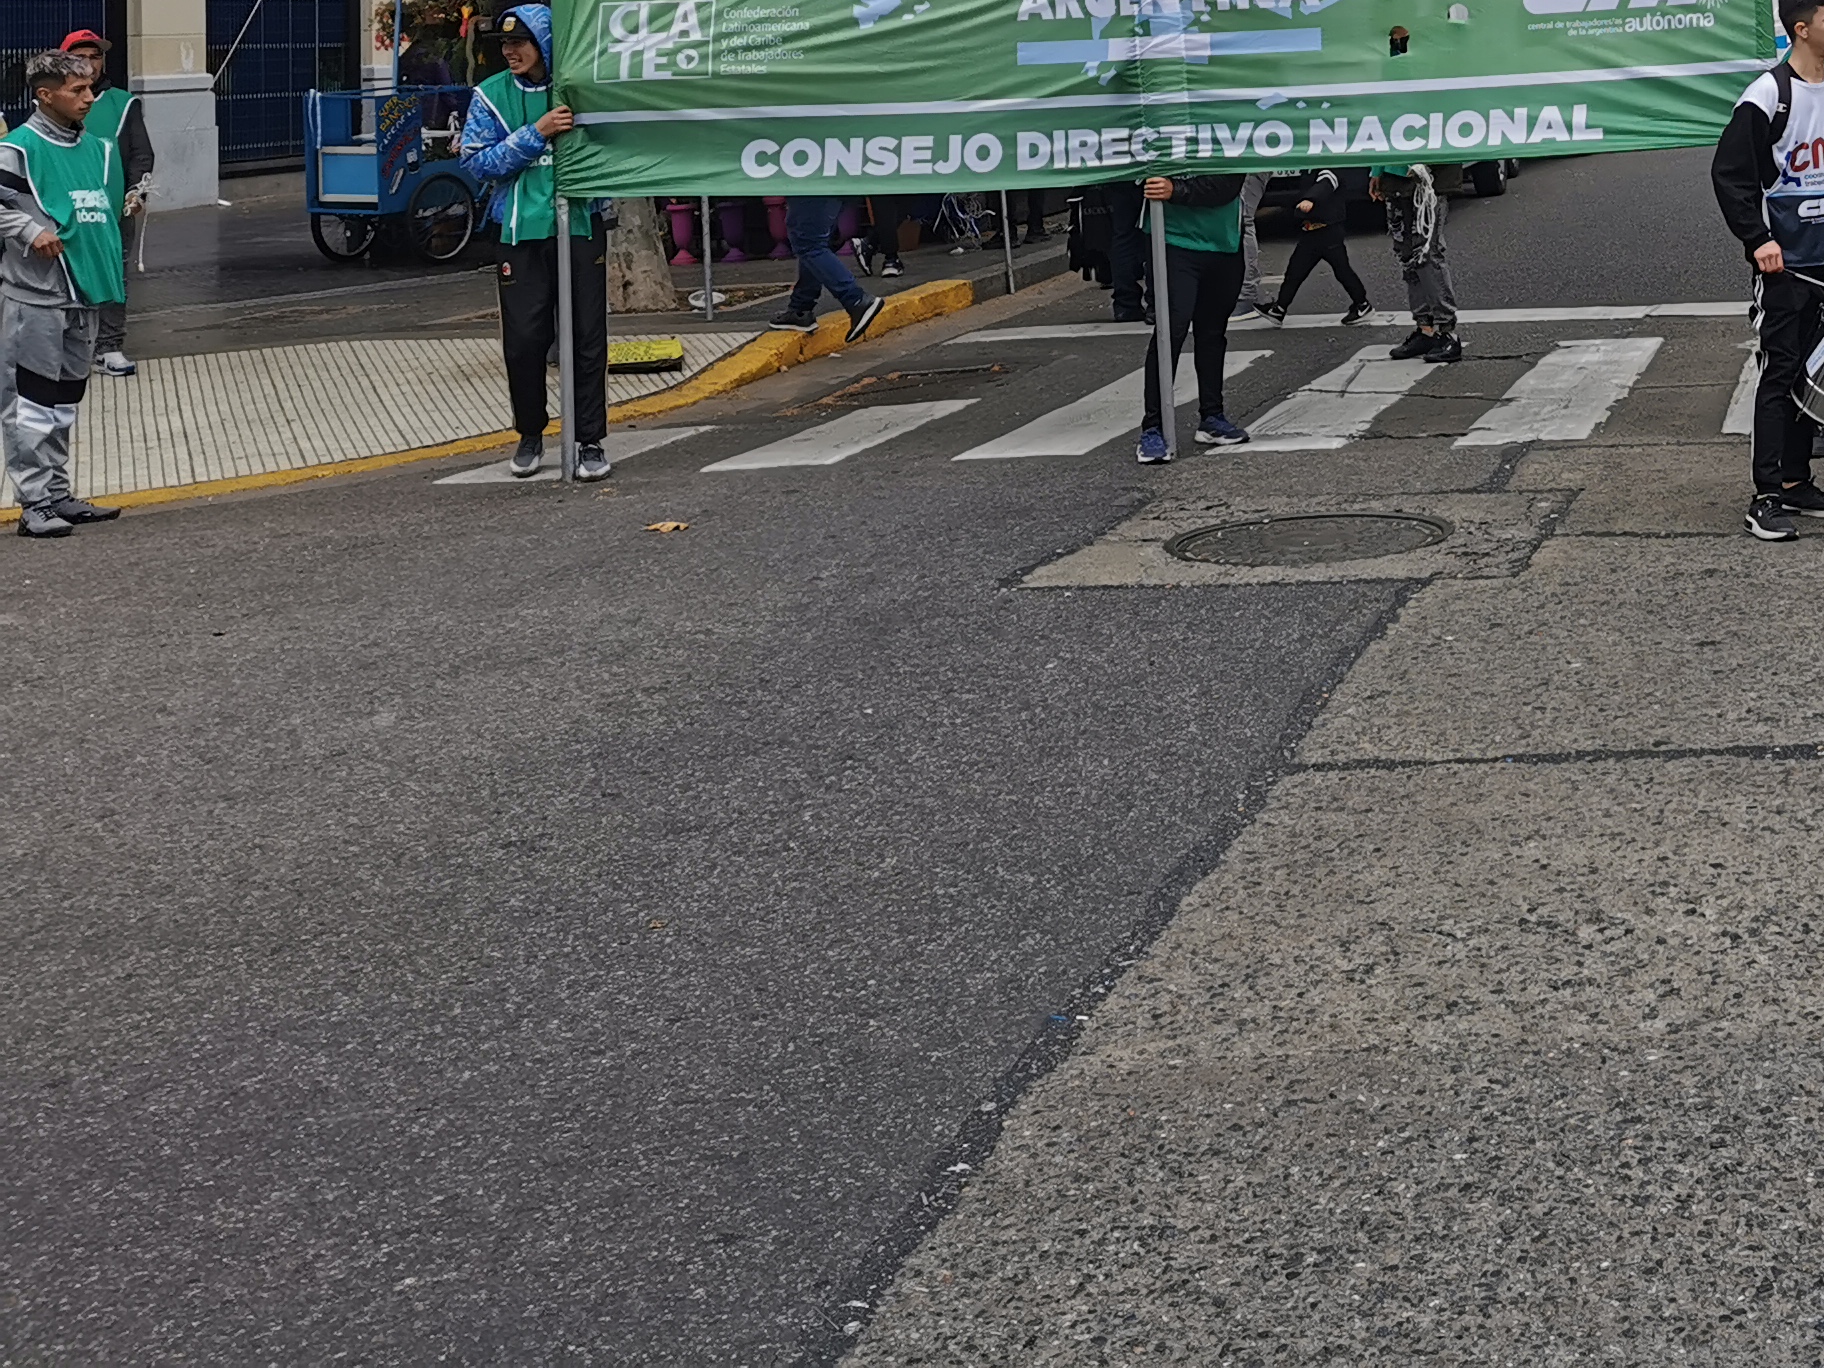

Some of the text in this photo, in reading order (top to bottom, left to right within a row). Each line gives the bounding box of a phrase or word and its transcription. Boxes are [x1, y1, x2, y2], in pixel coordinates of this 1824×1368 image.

[723, 6, 799, 18] Confederación
[722, 21, 810, 32] Latinoamericana
[1625, 12, 1714, 33] autónoma
[720, 36, 783, 49] y del Caribe
[720, 49, 804, 62] de Trabajadores
[720, 64, 767, 75] Estatales
[740, 104, 1603, 178] CONSEJO DIRECTIVO NACIONAL
